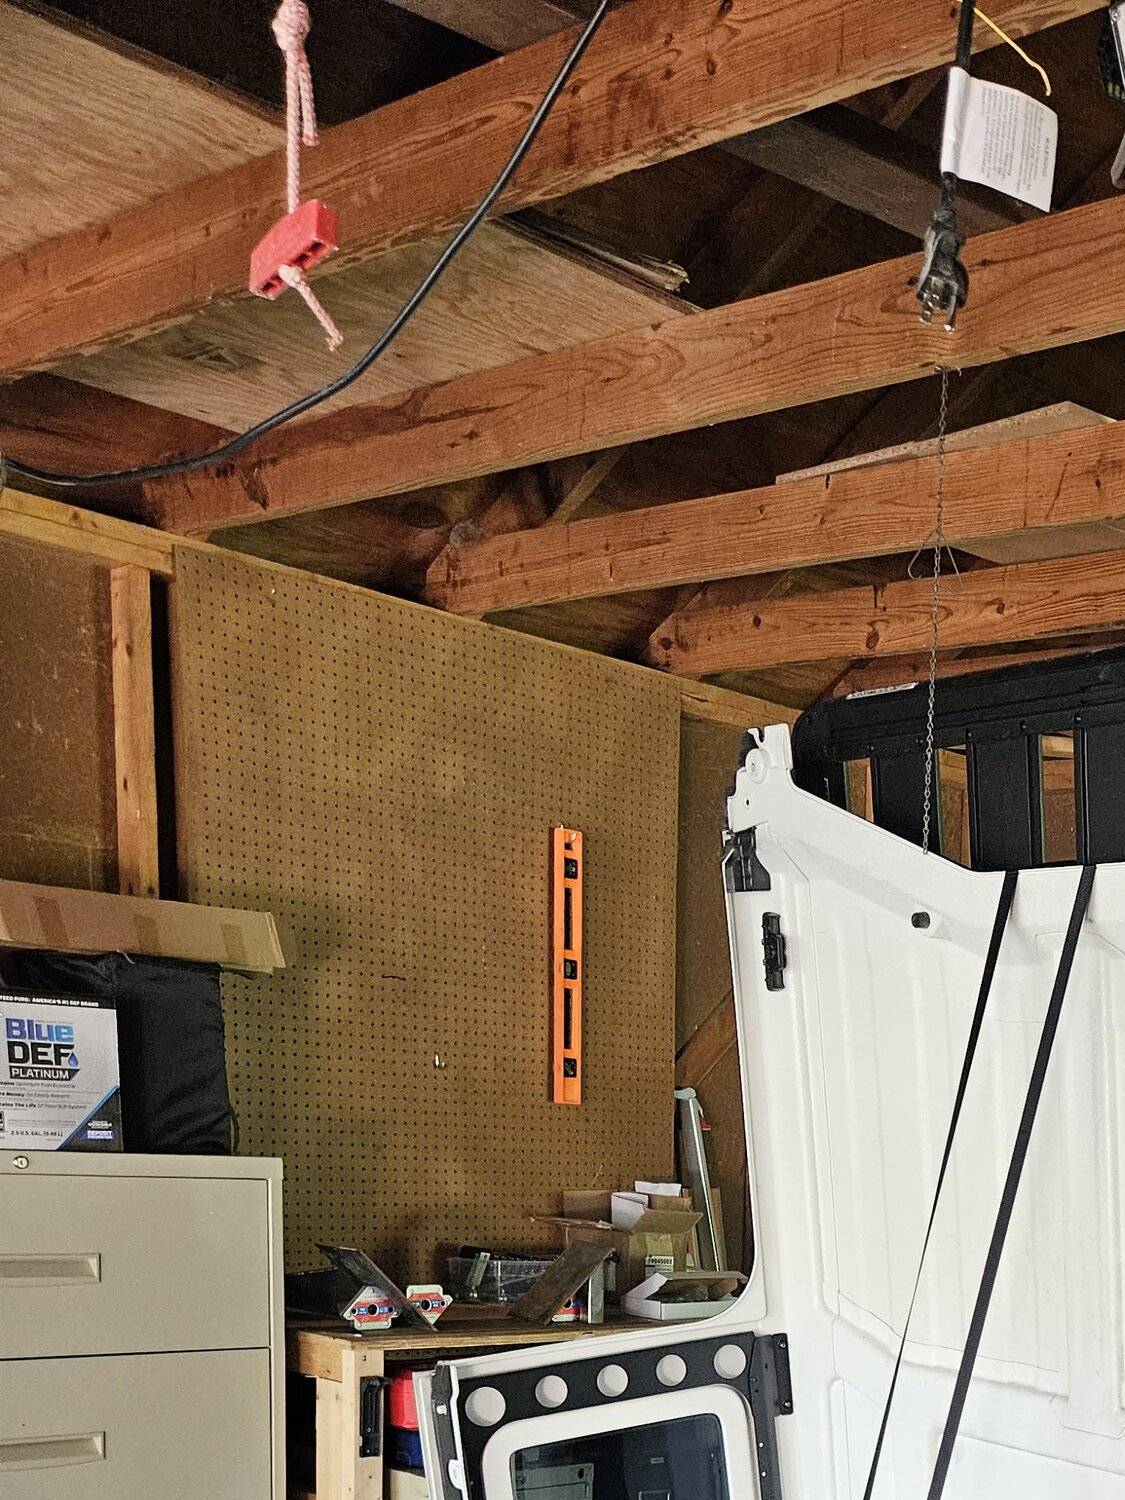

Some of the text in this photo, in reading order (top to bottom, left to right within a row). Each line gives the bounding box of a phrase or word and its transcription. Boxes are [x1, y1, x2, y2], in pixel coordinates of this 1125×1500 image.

[6, 1018, 74, 1042] Blue
[7, 1041, 75, 1066] DEF
[12, 1069, 70, 1079] PLATINUM
